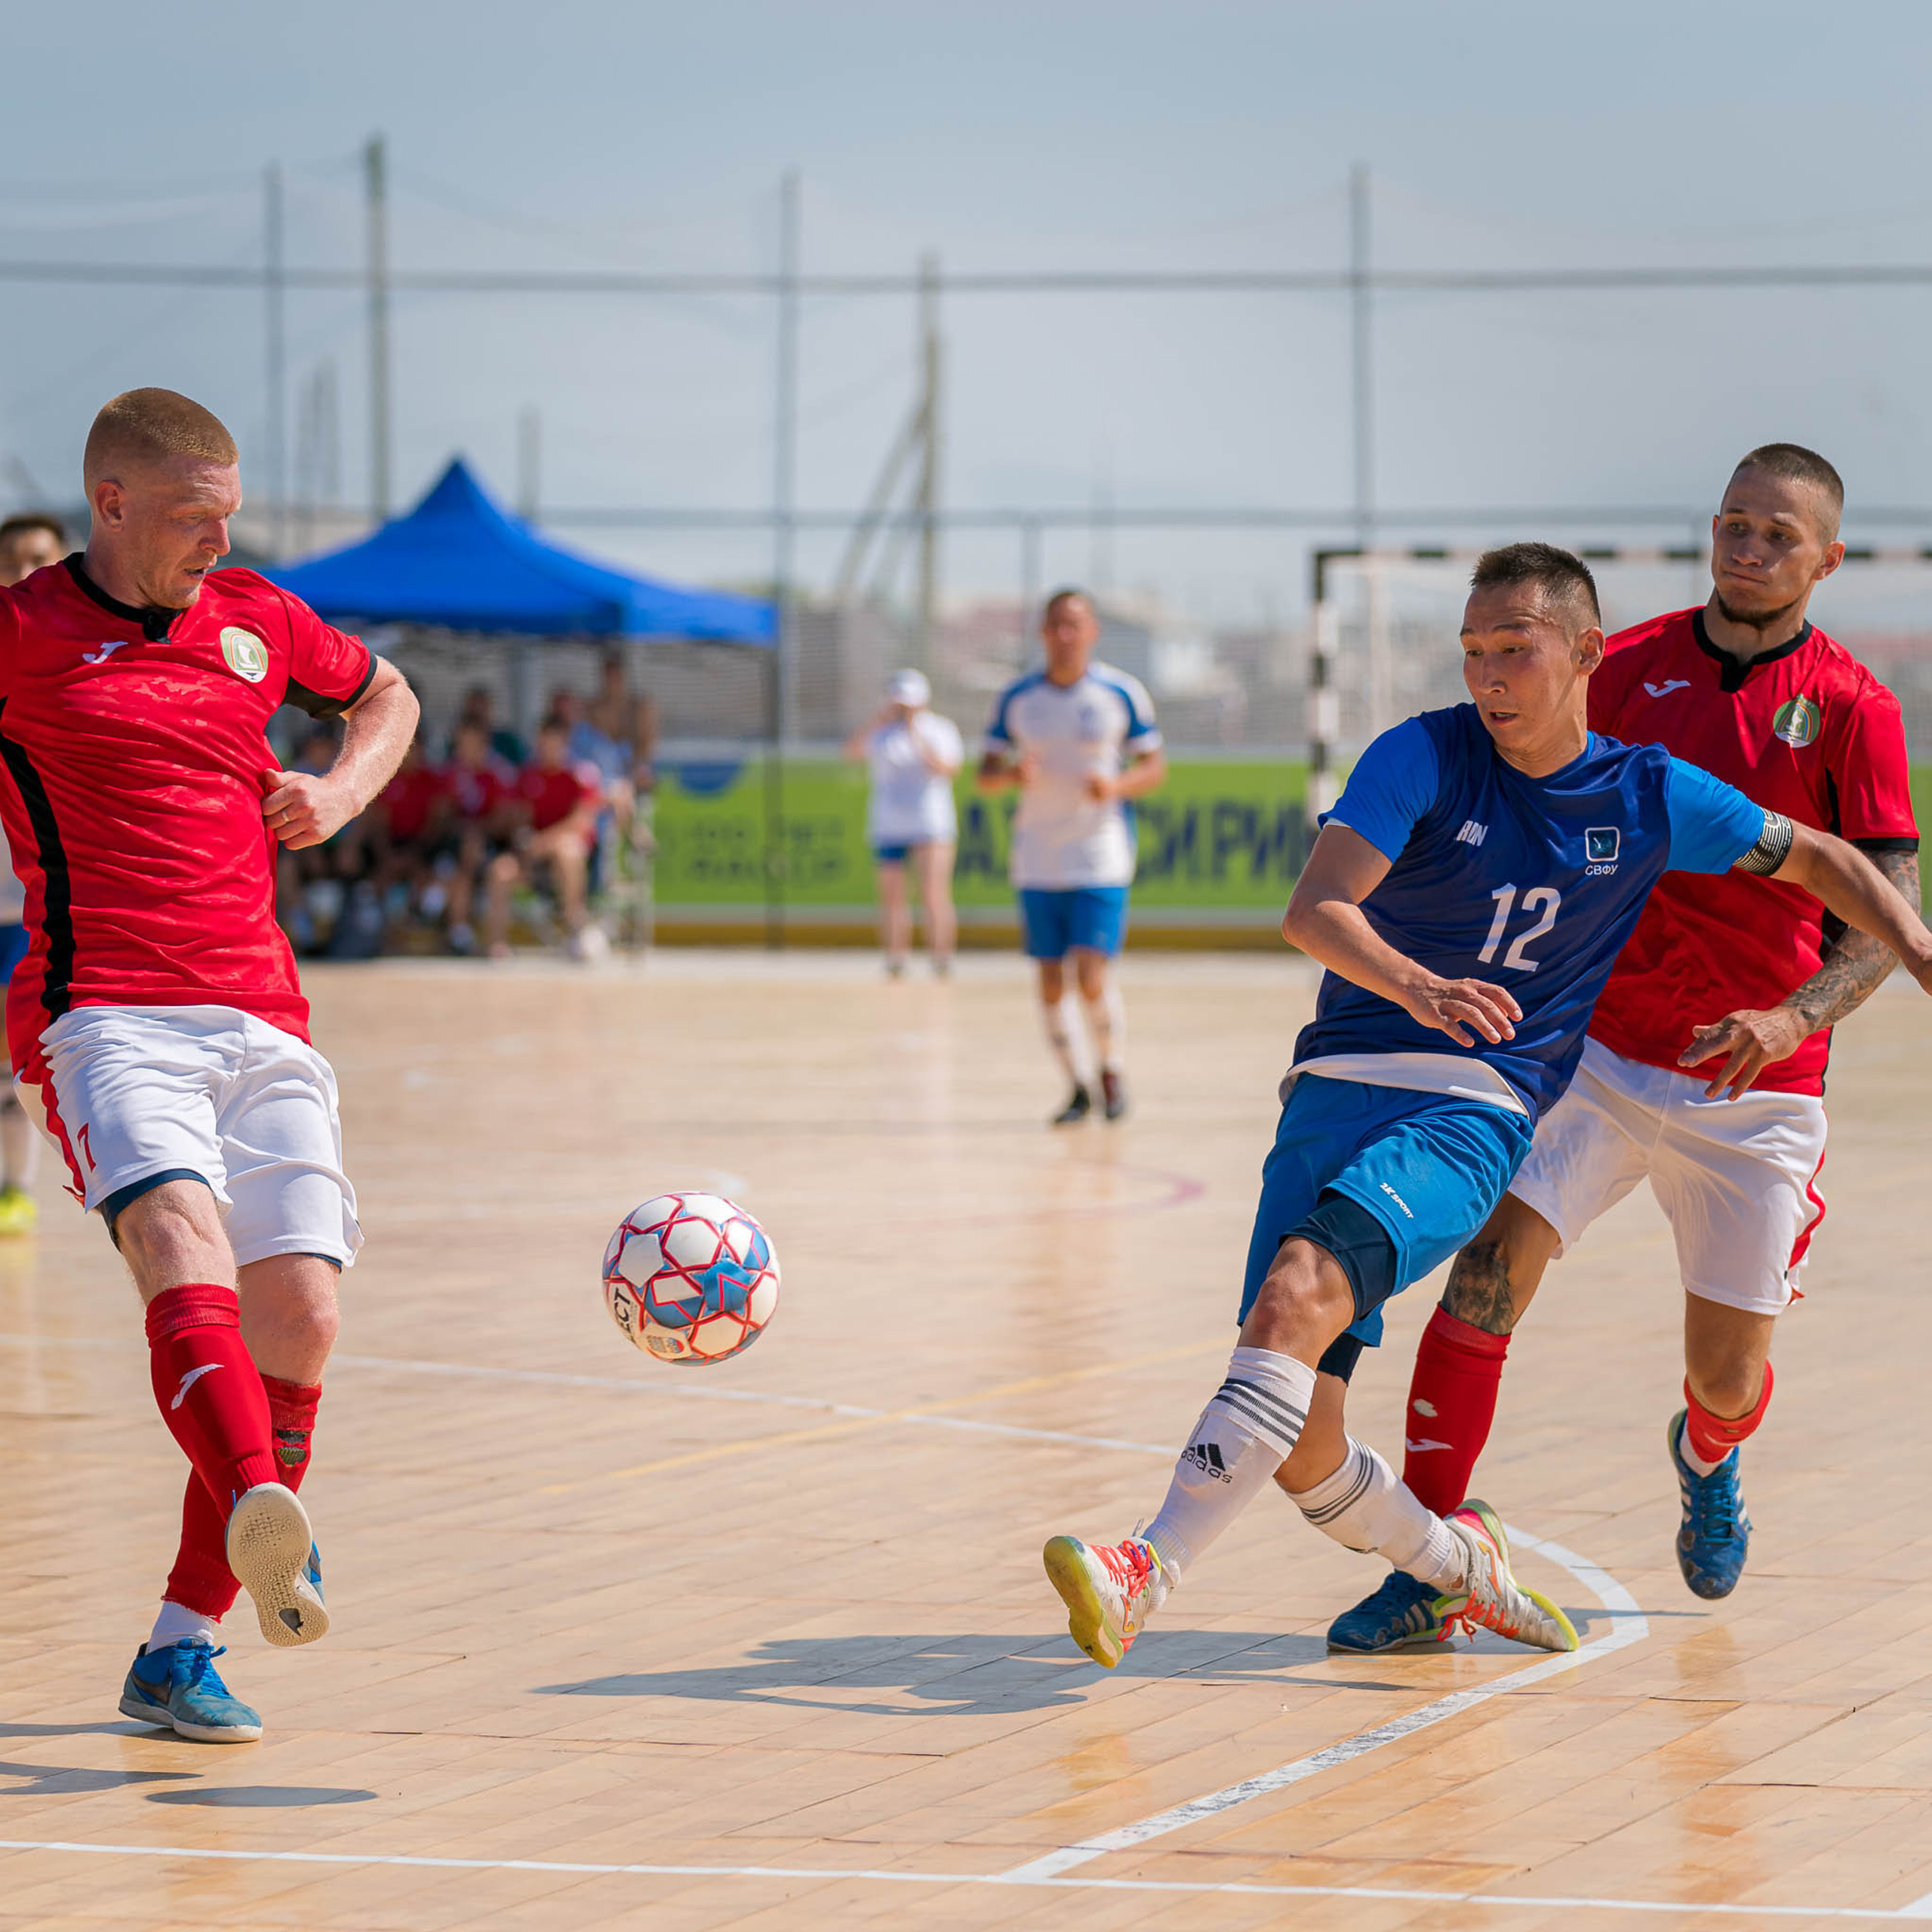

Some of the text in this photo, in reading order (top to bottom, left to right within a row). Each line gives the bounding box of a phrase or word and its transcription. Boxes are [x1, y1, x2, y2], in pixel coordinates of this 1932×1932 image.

[1585, 864, 1618, 875] СВФУ
[1477, 883, 1561, 972] 12
[1390, 1194, 1414, 1219] SPORT
[1180, 1447, 1232, 1484] adidas
